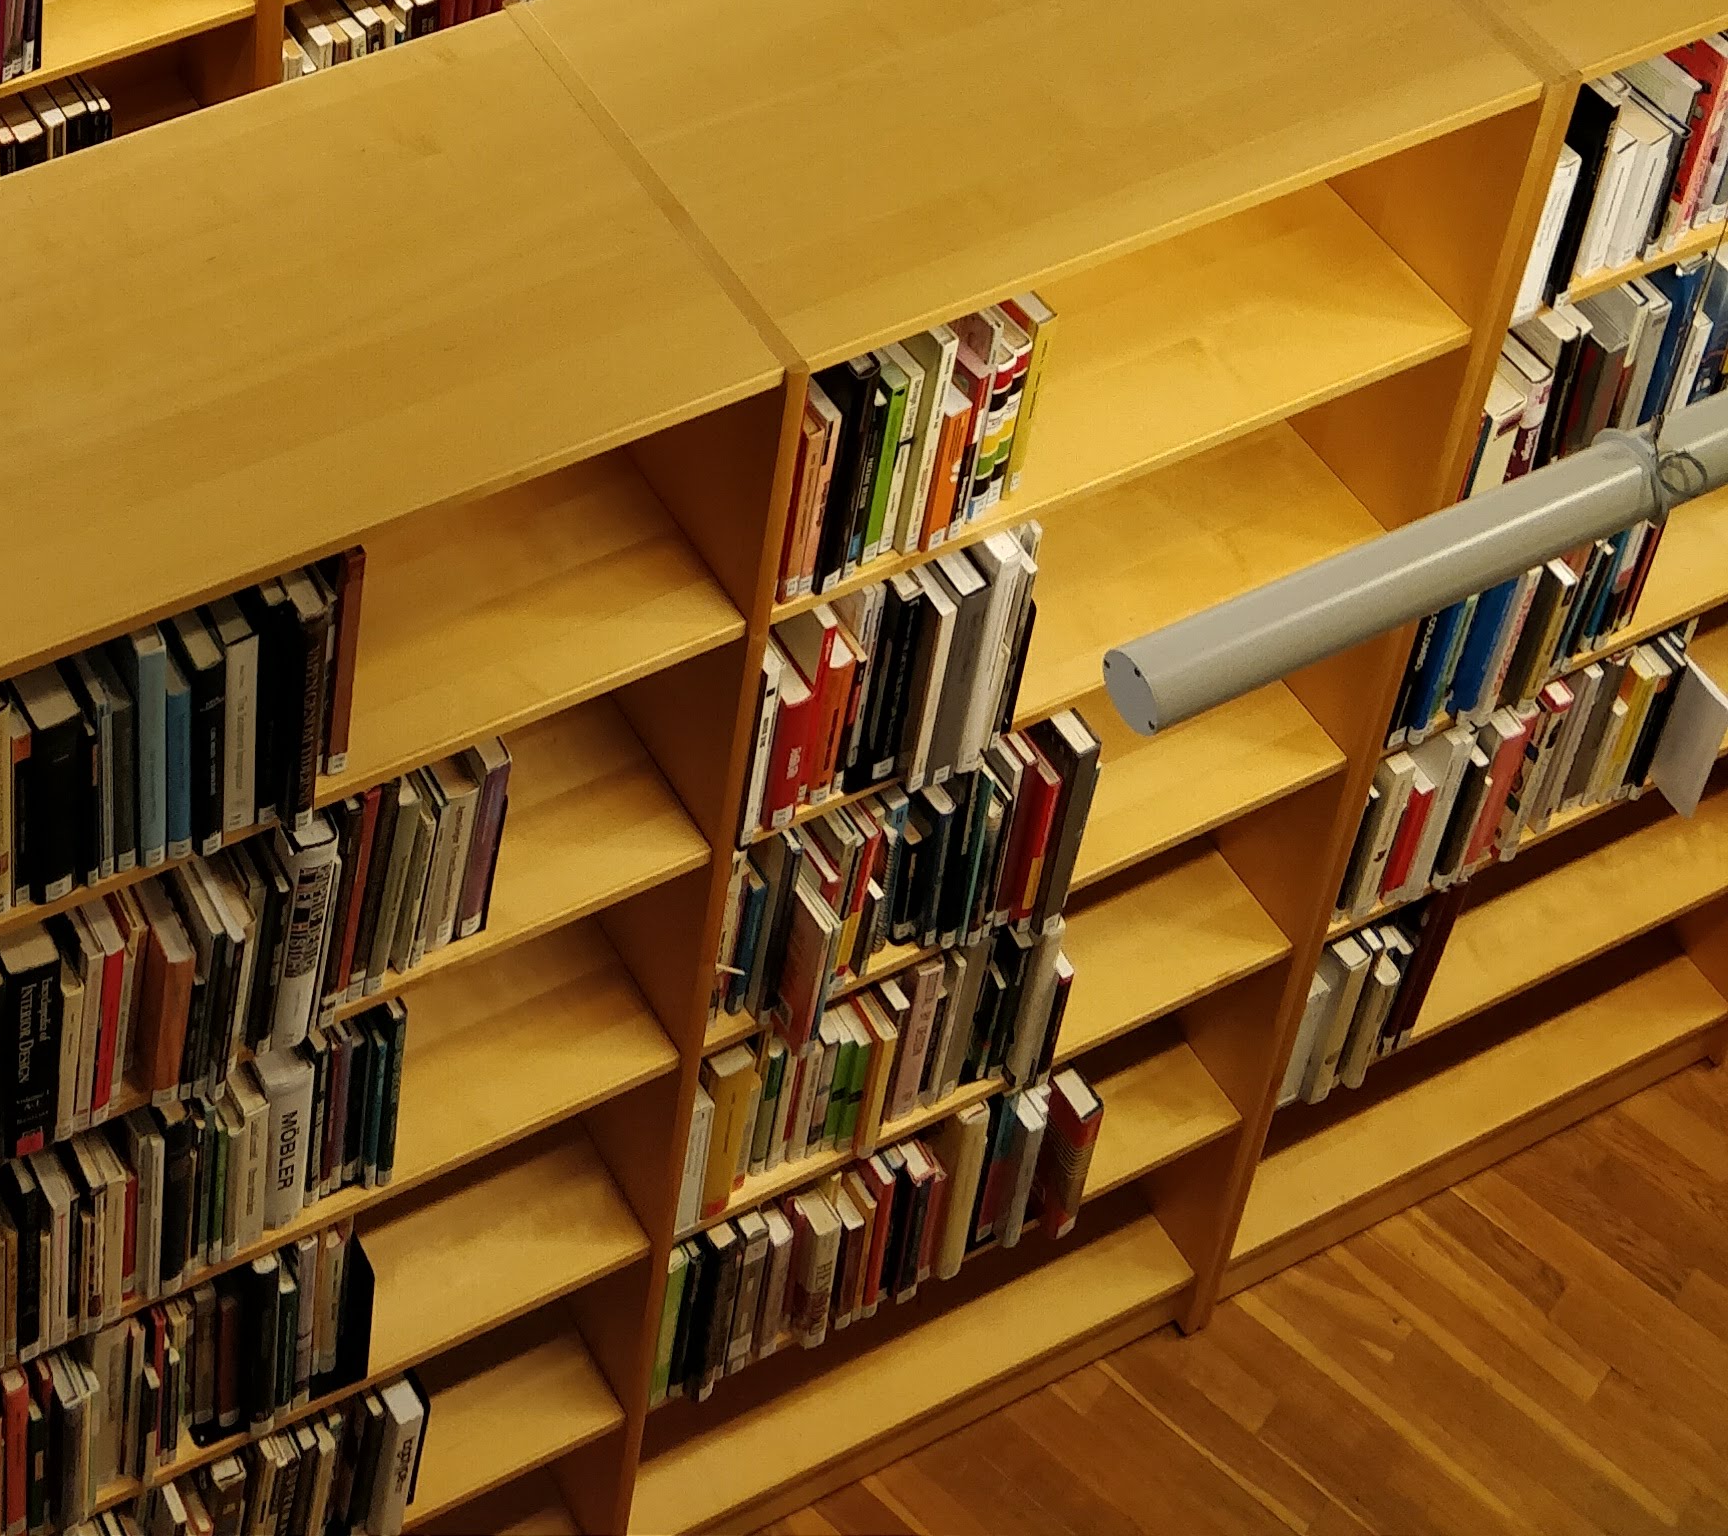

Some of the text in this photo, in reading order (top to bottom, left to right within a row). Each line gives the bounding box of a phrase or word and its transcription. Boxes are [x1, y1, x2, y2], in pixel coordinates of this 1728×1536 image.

[18, 981, 37, 1084] INTERIOR DESIGN
[276, 1110, 298, 1192] MÖBLER
